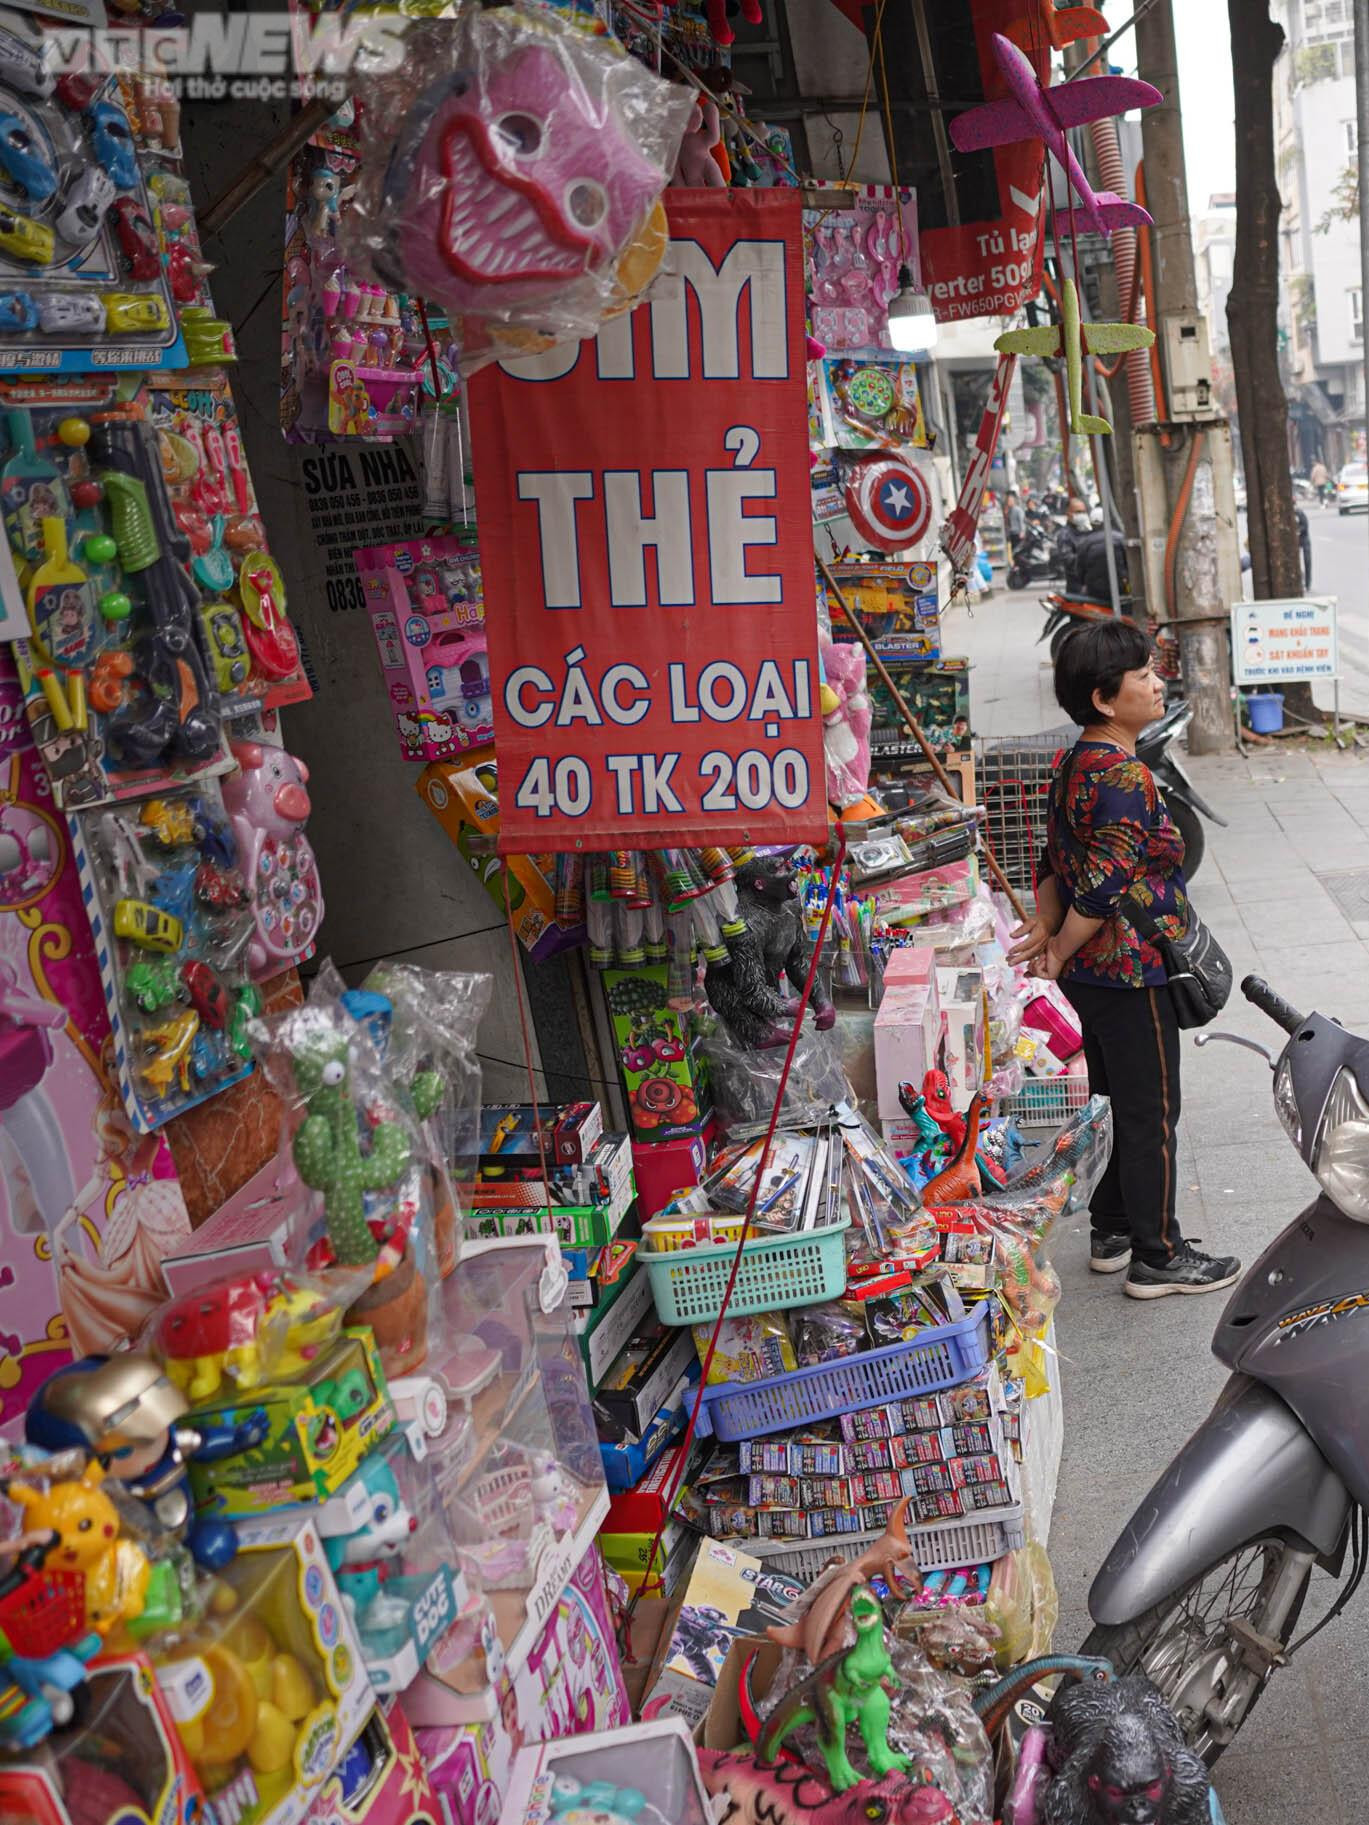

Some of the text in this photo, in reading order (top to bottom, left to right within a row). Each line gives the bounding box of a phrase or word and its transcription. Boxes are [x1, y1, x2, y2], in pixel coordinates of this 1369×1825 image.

[977, 230, 1004, 257] Tủ
[302, 440, 416, 495] SỬA NHÀ
[516, 425, 783, 609] THẺ
[874, 641, 920, 650] BLASTER
[504, 644, 813, 739] CÁC LOẠI
[516, 755, 592, 818] 40
[606, 752, 686, 815] TK
[700, 748, 810, 812] 200
[856, 1264, 869, 1274] UNO
[1278, 1302, 1332, 1329] WAVE
[414, 1571, 447, 1622] CUTE
[534, 1553, 573, 1622] DREAMY
[418, 1591, 450, 1646] DOG
